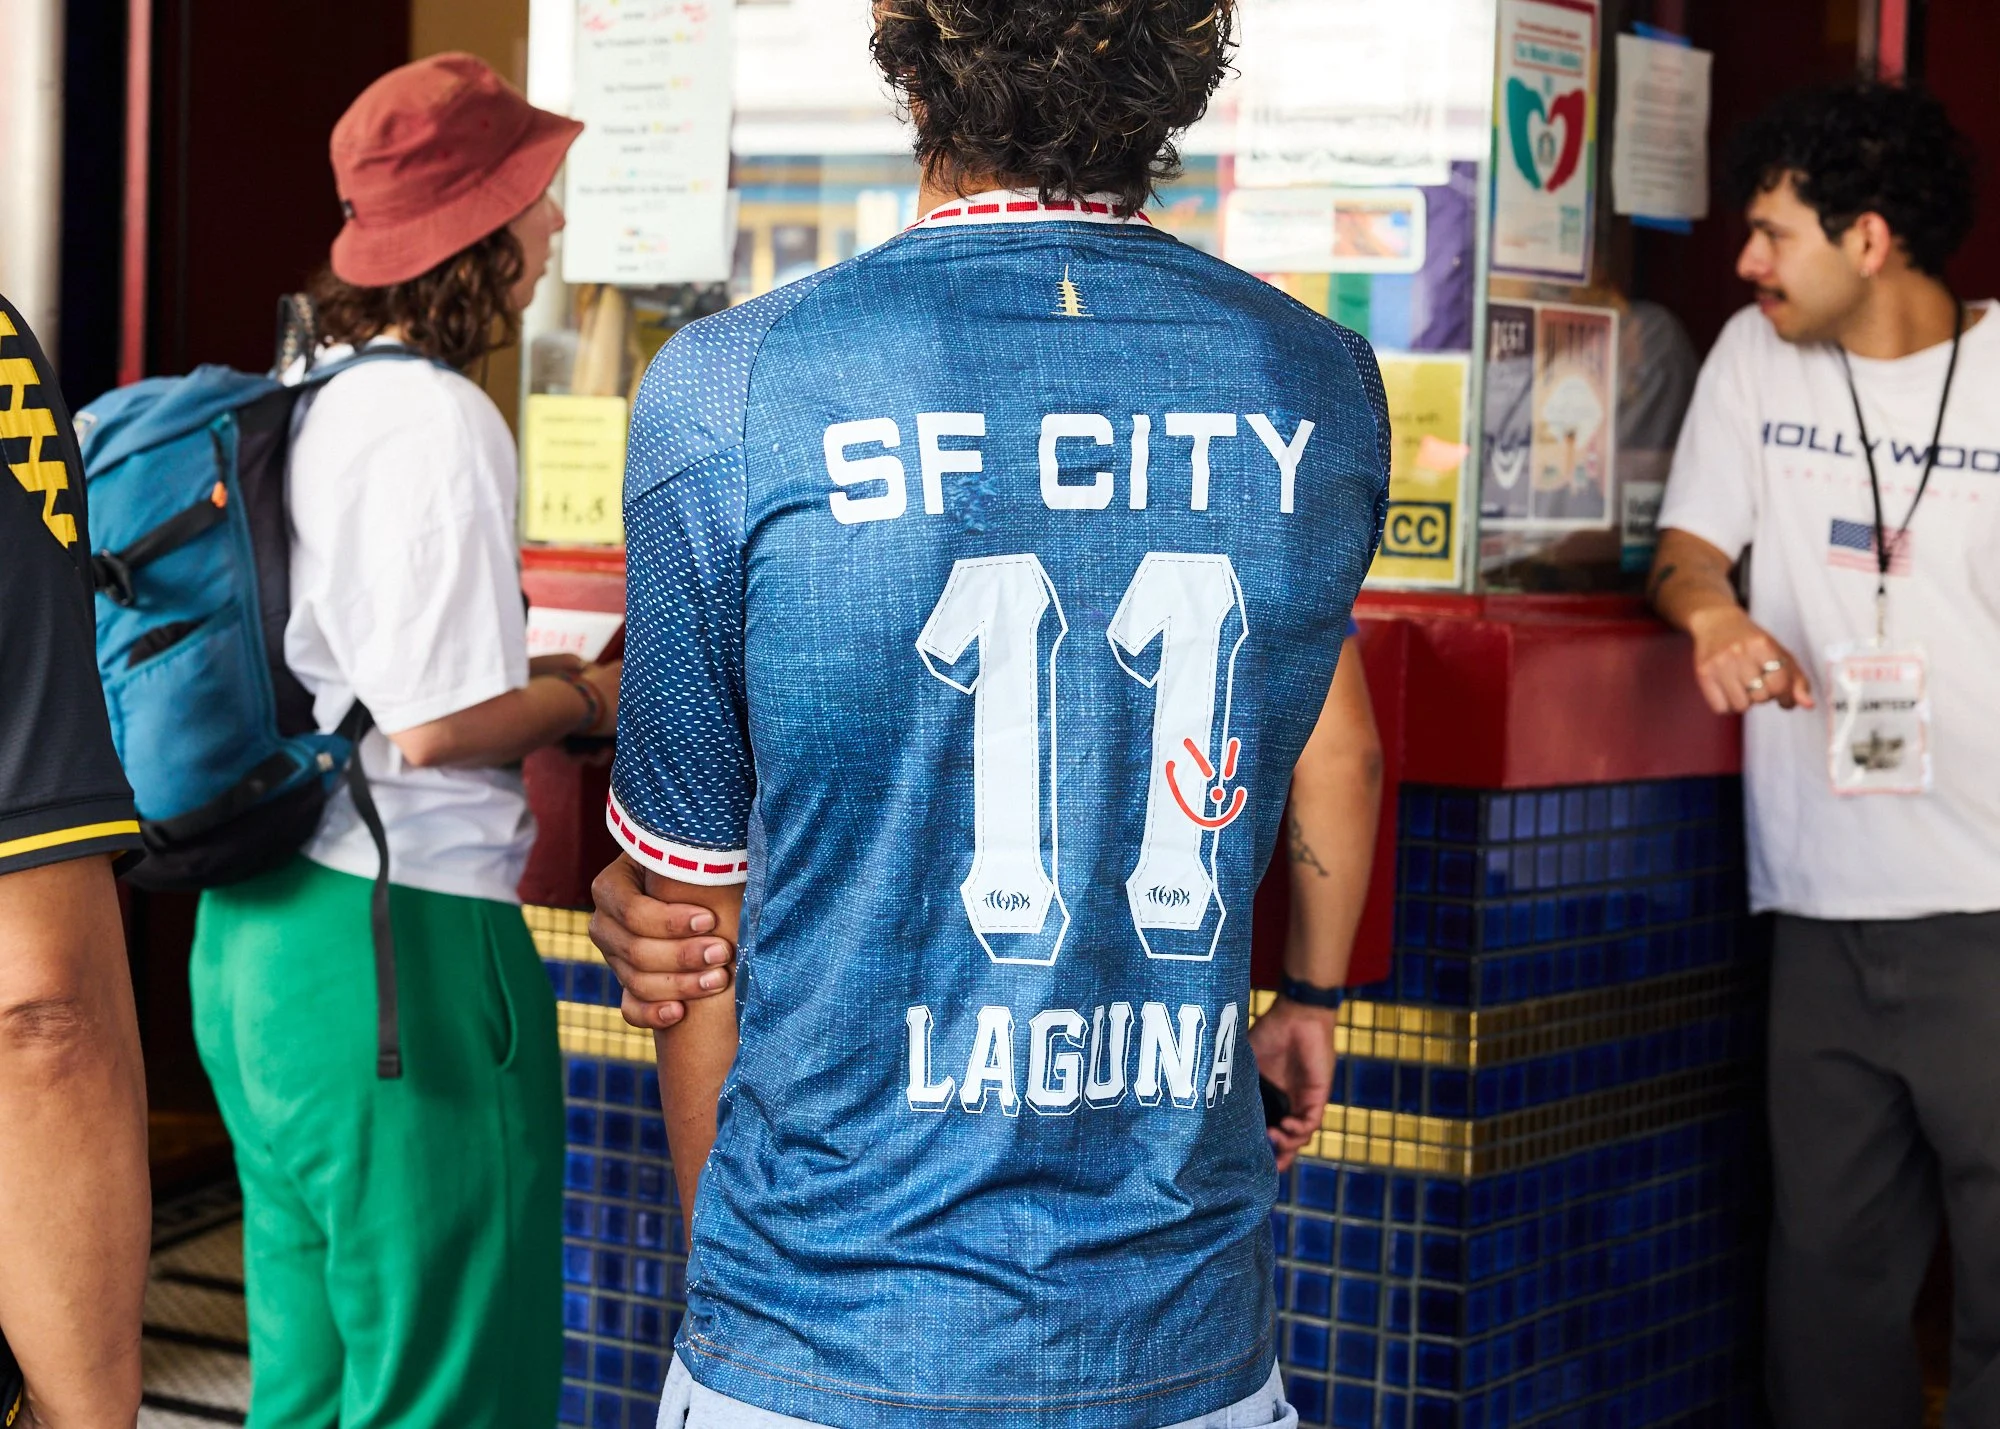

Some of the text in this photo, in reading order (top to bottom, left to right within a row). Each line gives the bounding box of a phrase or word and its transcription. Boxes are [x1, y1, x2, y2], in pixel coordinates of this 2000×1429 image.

[823, 412, 1316, 525] SF CITY
[1392, 513, 1438, 546] CC
[914, 551, 1250, 967] 11
[906, 1001, 1239, 1118] LAGUNA
